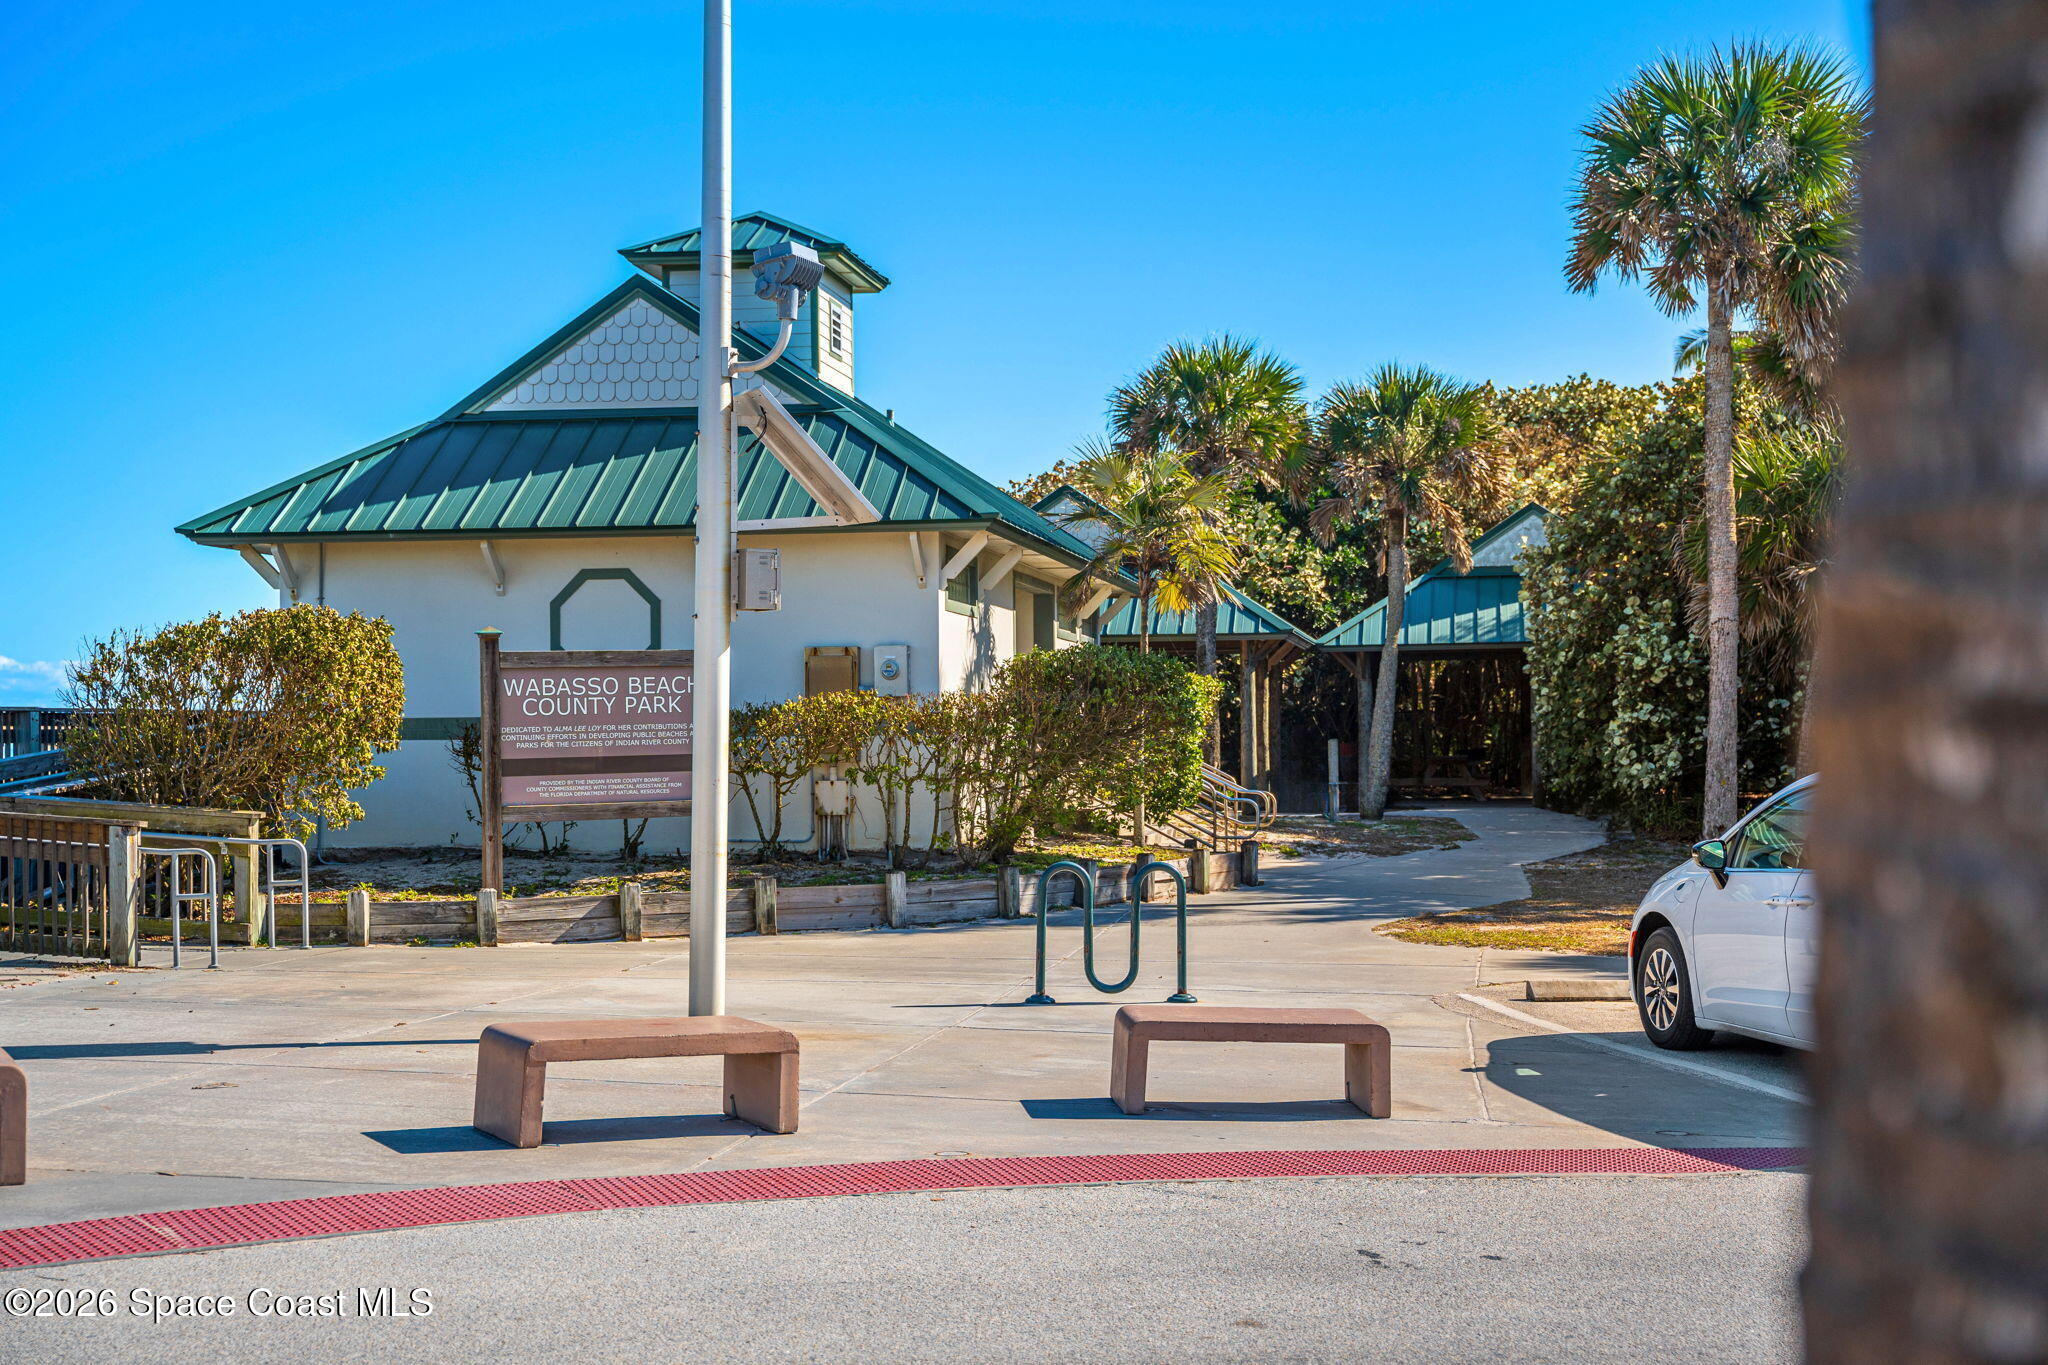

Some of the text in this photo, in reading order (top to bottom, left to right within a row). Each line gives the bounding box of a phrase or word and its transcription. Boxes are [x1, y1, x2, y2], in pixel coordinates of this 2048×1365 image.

[503, 677, 619, 697] WABASSO
[522, 696, 682, 716] COUNTY PARK
